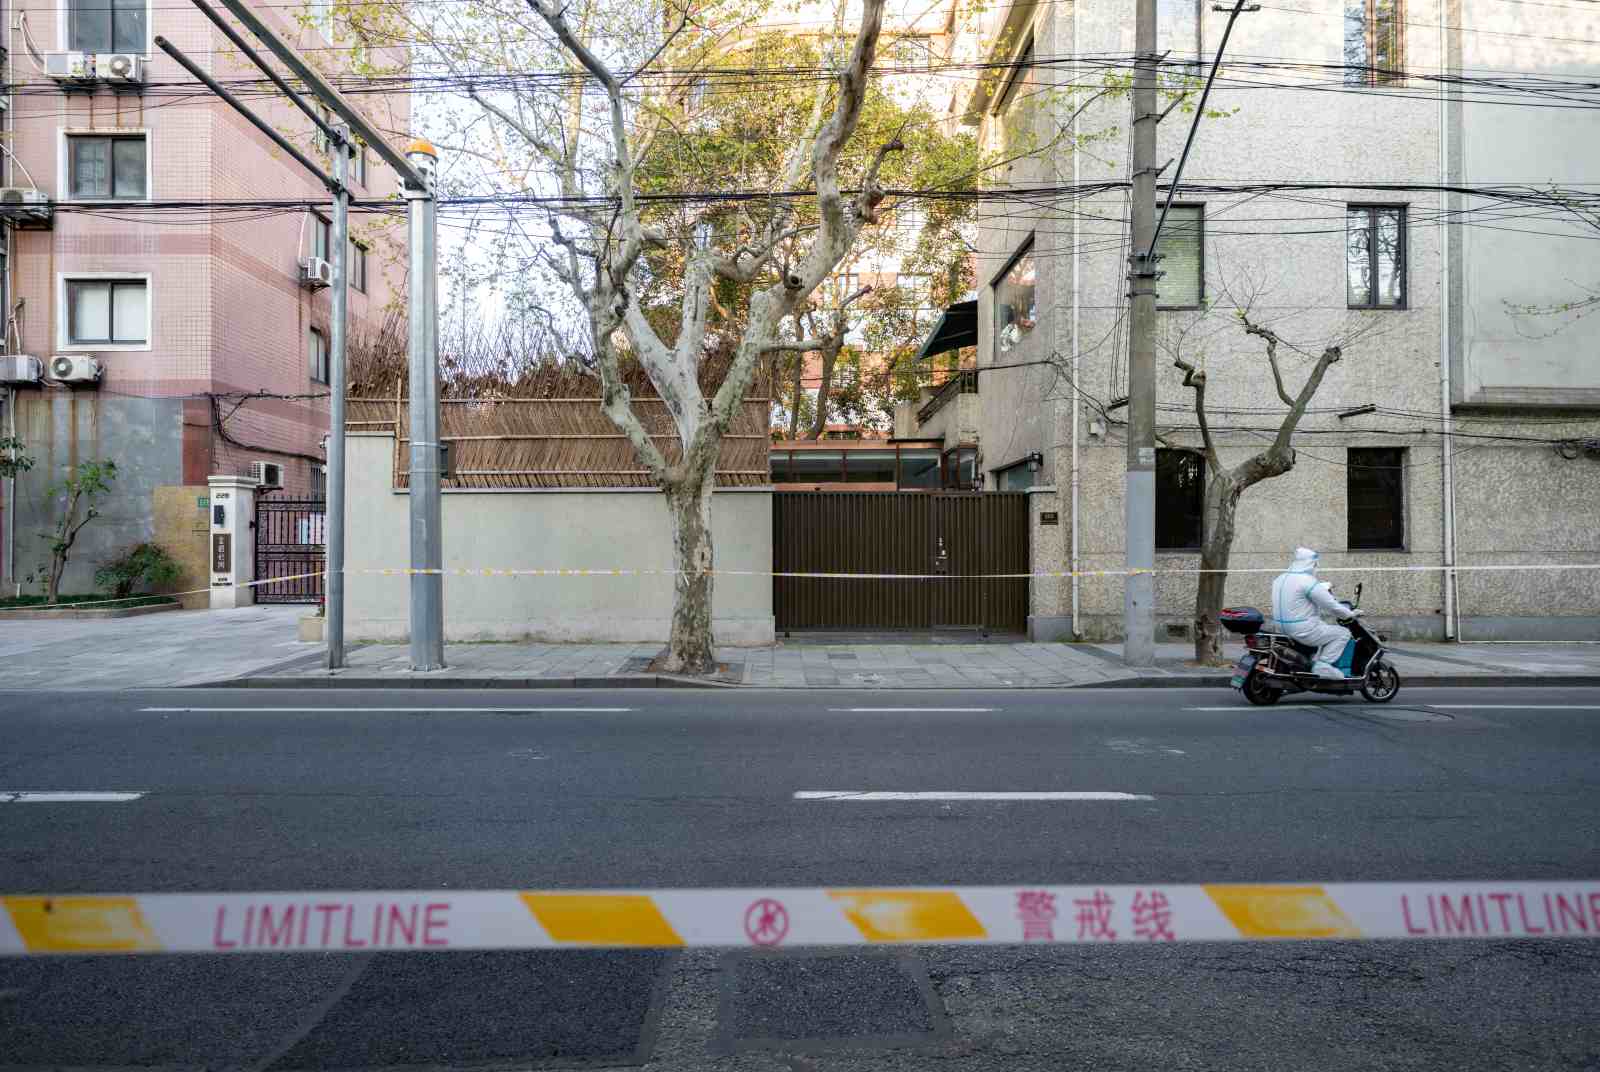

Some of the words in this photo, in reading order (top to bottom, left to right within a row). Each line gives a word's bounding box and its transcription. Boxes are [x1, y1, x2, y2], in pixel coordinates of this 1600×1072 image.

[213, 902, 450, 949] LIMITLINE
[1016, 887, 1177, 942] 警戒线
